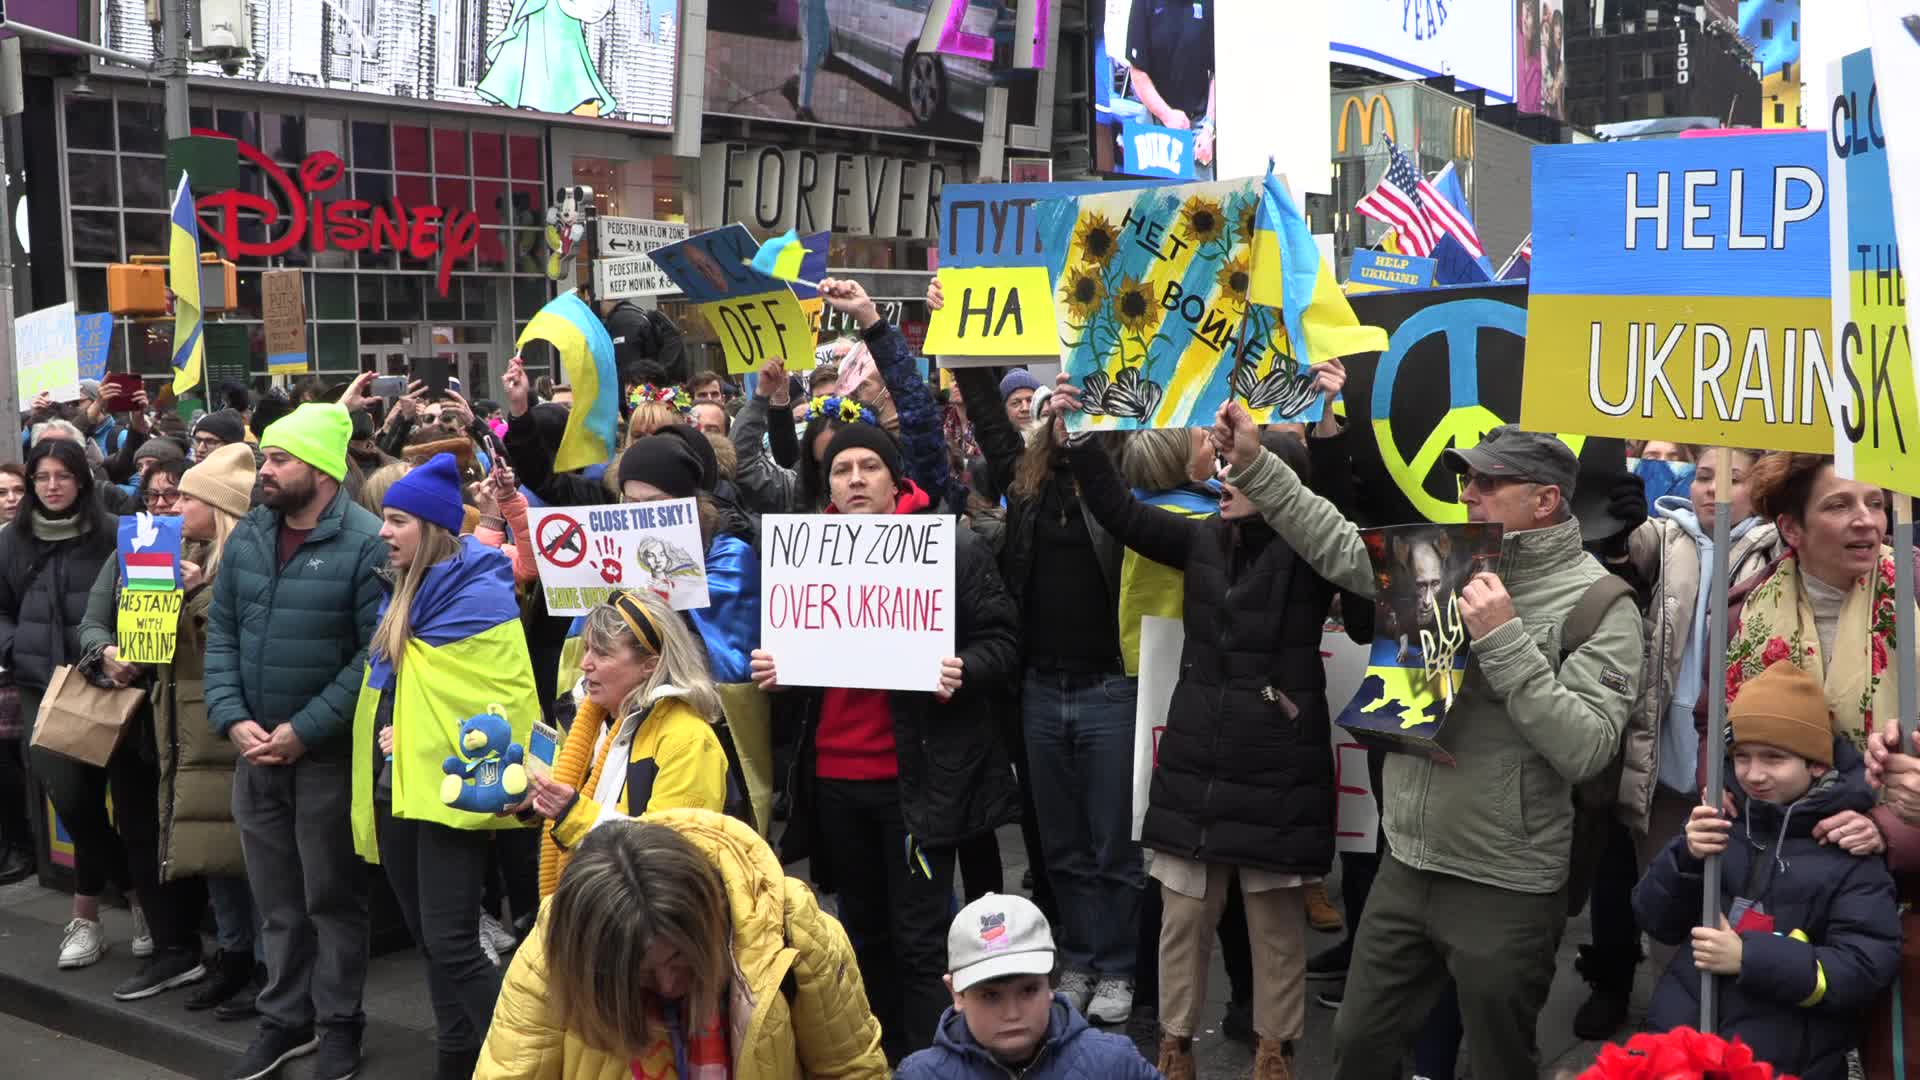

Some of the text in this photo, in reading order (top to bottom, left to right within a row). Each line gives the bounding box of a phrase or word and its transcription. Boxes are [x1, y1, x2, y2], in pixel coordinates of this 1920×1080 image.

[1677, 29, 1688, 84] 1500
[1134, 132, 1184, 175] DUKE
[722, 143, 945, 238] FOREVER
[1624, 166, 1825, 251] HELP
[607, 222, 685, 239] PEDESTRIAN FLOW ZONE
[1121, 208, 1188, 261] НЕТ
[608, 261, 651, 276] PEDESTRIAN
[610, 277, 655, 292] KEEP MOVING
[1361, 267, 1419, 286] UKRAINE
[1376, 256, 1409, 269] HELP
[719, 300, 787, 366] OFF
[958, 287, 1023, 338] НА
[1161, 281, 1266, 369] ВОЙНЕ
[1588, 321, 1834, 427] UKRAIN
[1841, 322, 1912, 455] SK
[589, 510, 629, 533] CLOSE
[630, 508, 657, 530] THE
[658, 505, 683, 527] SKY
[770, 522, 943, 568] NO FLY ZONE
[547, 587, 582, 609] SAVE
[769, 583, 944, 632] OVER UKRAINE
[119, 631, 176, 661] UKRAINE
[137, 617, 163, 631] WITH
